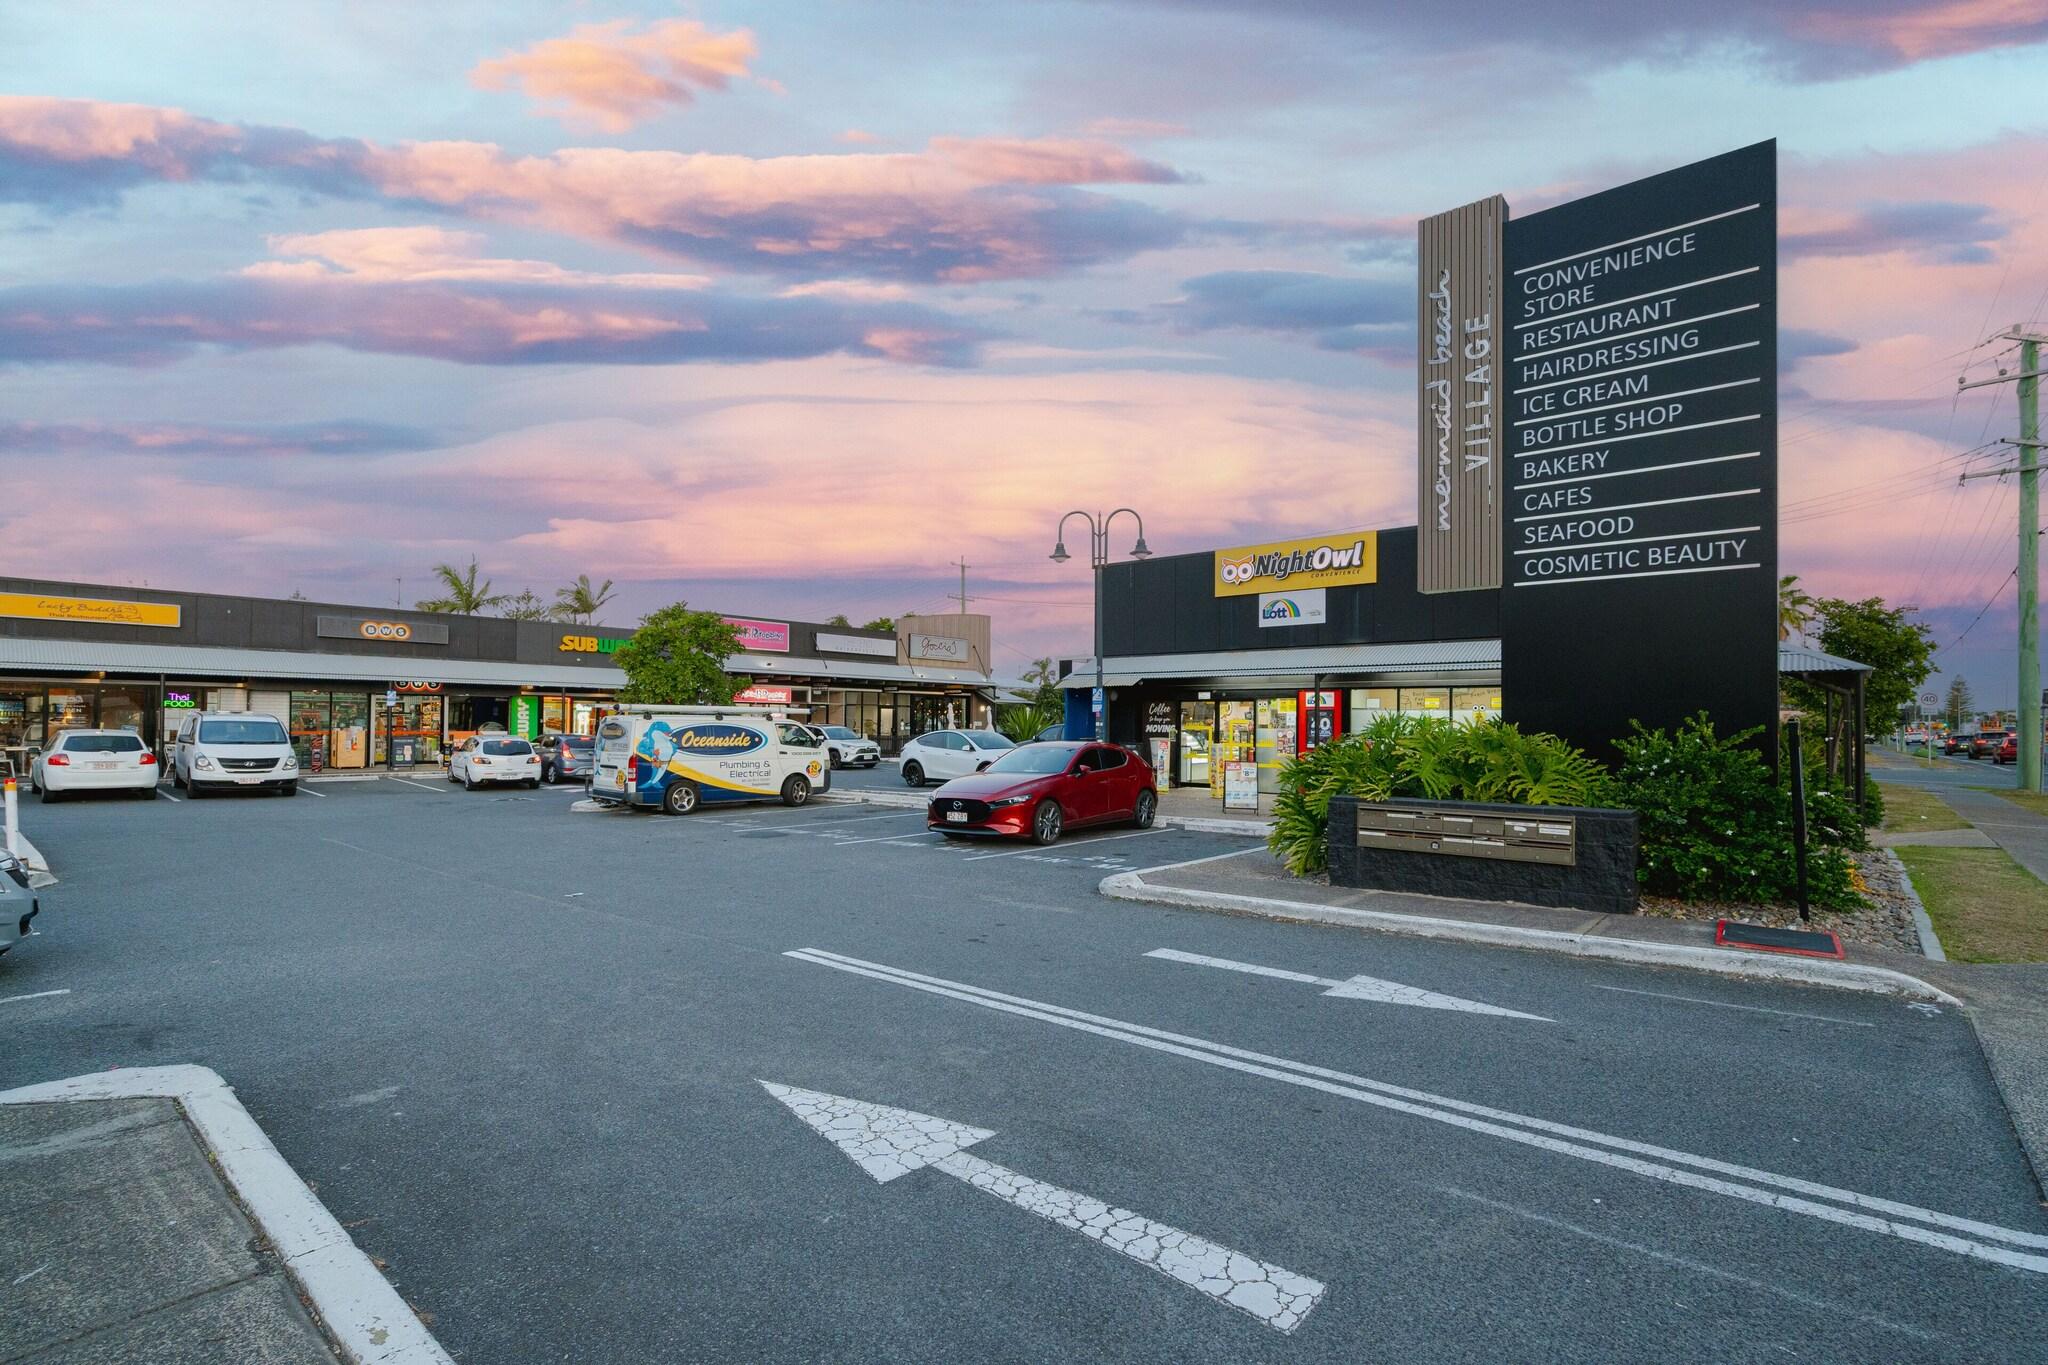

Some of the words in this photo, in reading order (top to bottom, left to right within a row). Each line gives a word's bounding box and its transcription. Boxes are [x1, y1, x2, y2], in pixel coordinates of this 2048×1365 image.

[1523, 233, 1696, 294] CONVENIENCE
[1428, 268, 1452, 365] beach
[1523, 284, 1595, 318] STORE
[1523, 298, 1677, 350] RESTAURANT
[1523, 329, 1699, 382] HAIRDRESSING
[1465, 313, 1489, 472] VILLAGE
[1523, 392, 1556, 415] ICE
[1563, 375, 1649, 407] CREAM
[1523, 416, 1607, 447] BOTTLE
[1614, 403, 1683, 431] SHOP
[1425, 379, 1451, 531] mermaid
[1523, 450, 1610, 480] BAKERY
[1523, 486, 1592, 511] CAFES
[1524, 516, 1634, 544] SEAFOOD
[1255, 541, 1365, 580] NightOwl
[1310, 569, 1360, 579] CONVENIENCE
[1524, 549, 1640, 577] COSMETIC
[1648, 538, 1747, 567] BEAUTY
[164, 700, 195, 708] FOOD
[167, 692, 190, 700] Thai
[1149, 703, 1171, 715] Coffee
[681, 731, 752, 747] Oceanside
[719, 760, 761, 770] Plumbing
[763, 760, 771, 768] &
[729, 770, 771, 778] Electrical
